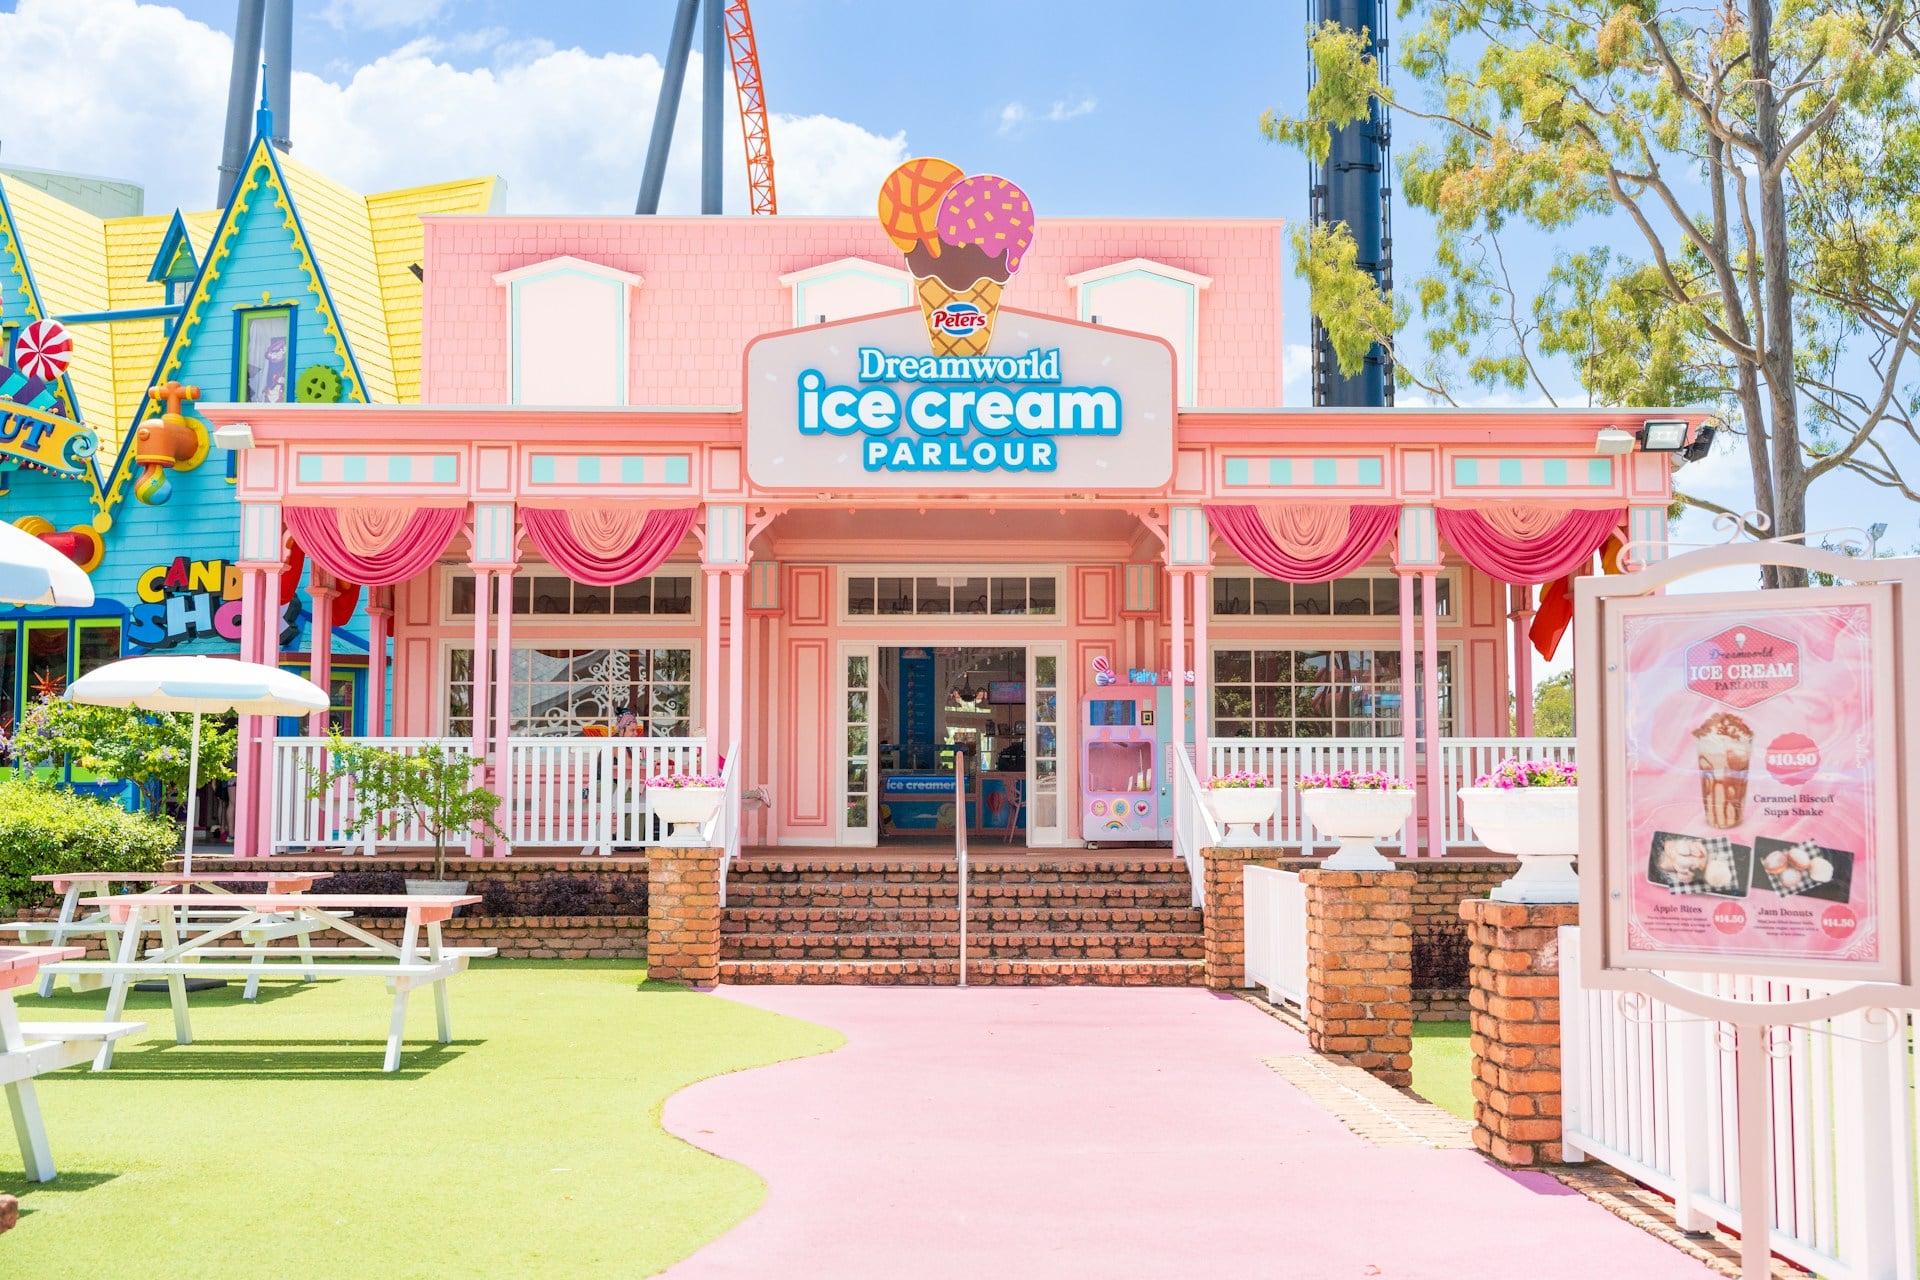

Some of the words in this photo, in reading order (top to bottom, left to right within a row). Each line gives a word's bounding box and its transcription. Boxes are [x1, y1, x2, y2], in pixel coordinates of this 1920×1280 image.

[932, 308, 986, 329] Peters
[860, 347, 1061, 381] Dreamworld
[802, 372, 897, 431] ice
[909, 388, 1118, 431] cream
[868, 441, 1053, 467] PARLOUR
[137, 556, 243, 603] CAND
[128, 593, 290, 644] SHO
[1709, 646, 1773, 659] Dreamworld
[1129, 668, 1158, 685] Fairy
[1690, 665, 1723, 680] ICE
[1727, 662, 1794, 679] CREAM
[1715, 681, 1769, 690] PARLOUR
[1768, 753, 1817, 766] $10.90
[886, 779, 904, 790] ice
[906, 781, 956, 790] creamer
[1753, 794, 1797, 803] Caramel
[1799, 794, 1835, 803] Biscoff
[1764, 807, 1789, 818] Supa
[1792, 807, 1824, 816] Shake
[1654, 904, 1678, 914] Apple
[1680, 904, 1702, 913] Bites
[1758, 907, 1778, 916] Jam
[1780, 908, 1813, 917] Donuts
